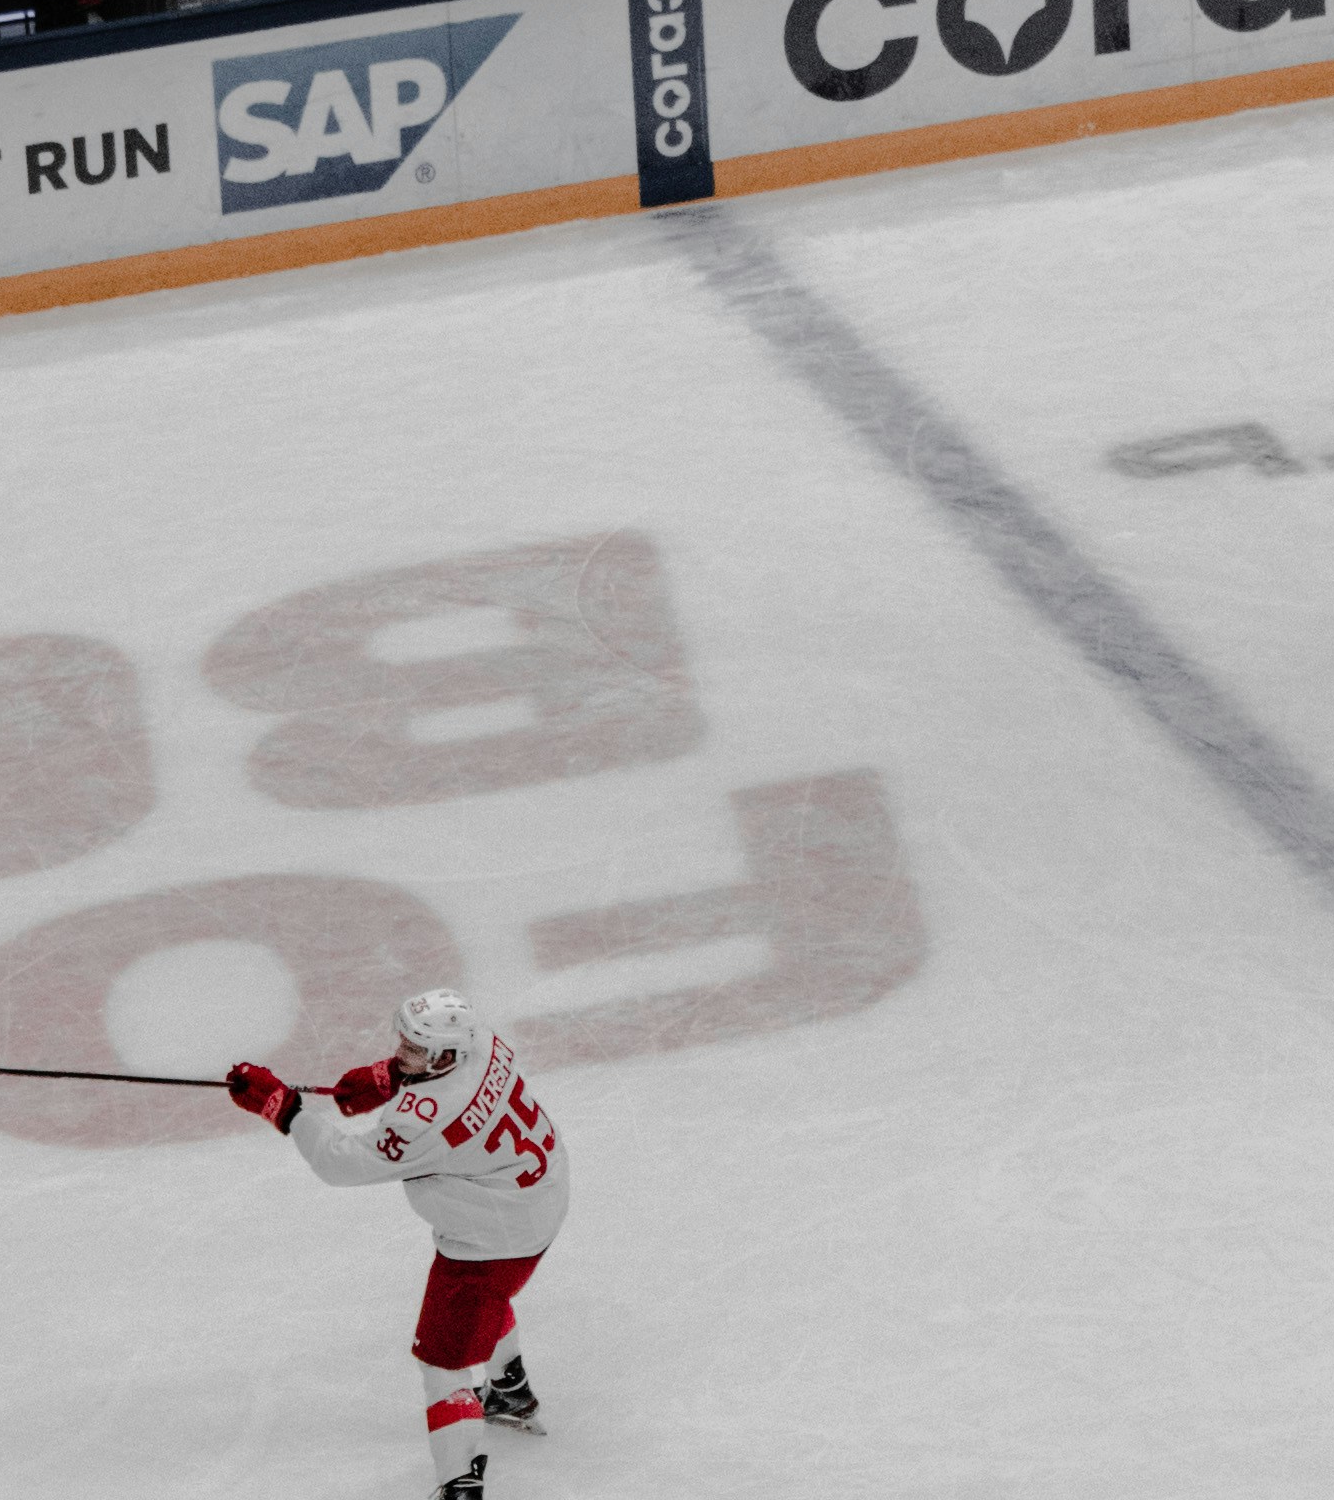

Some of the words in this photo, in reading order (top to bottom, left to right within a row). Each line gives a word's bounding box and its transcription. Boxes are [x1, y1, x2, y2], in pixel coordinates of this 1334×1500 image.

[25, 122, 172, 195] RUN
[219, 57, 448, 183] SAP
[376, 1127, 410, 1162] 35
[483, 1073, 557, 1189] 35
